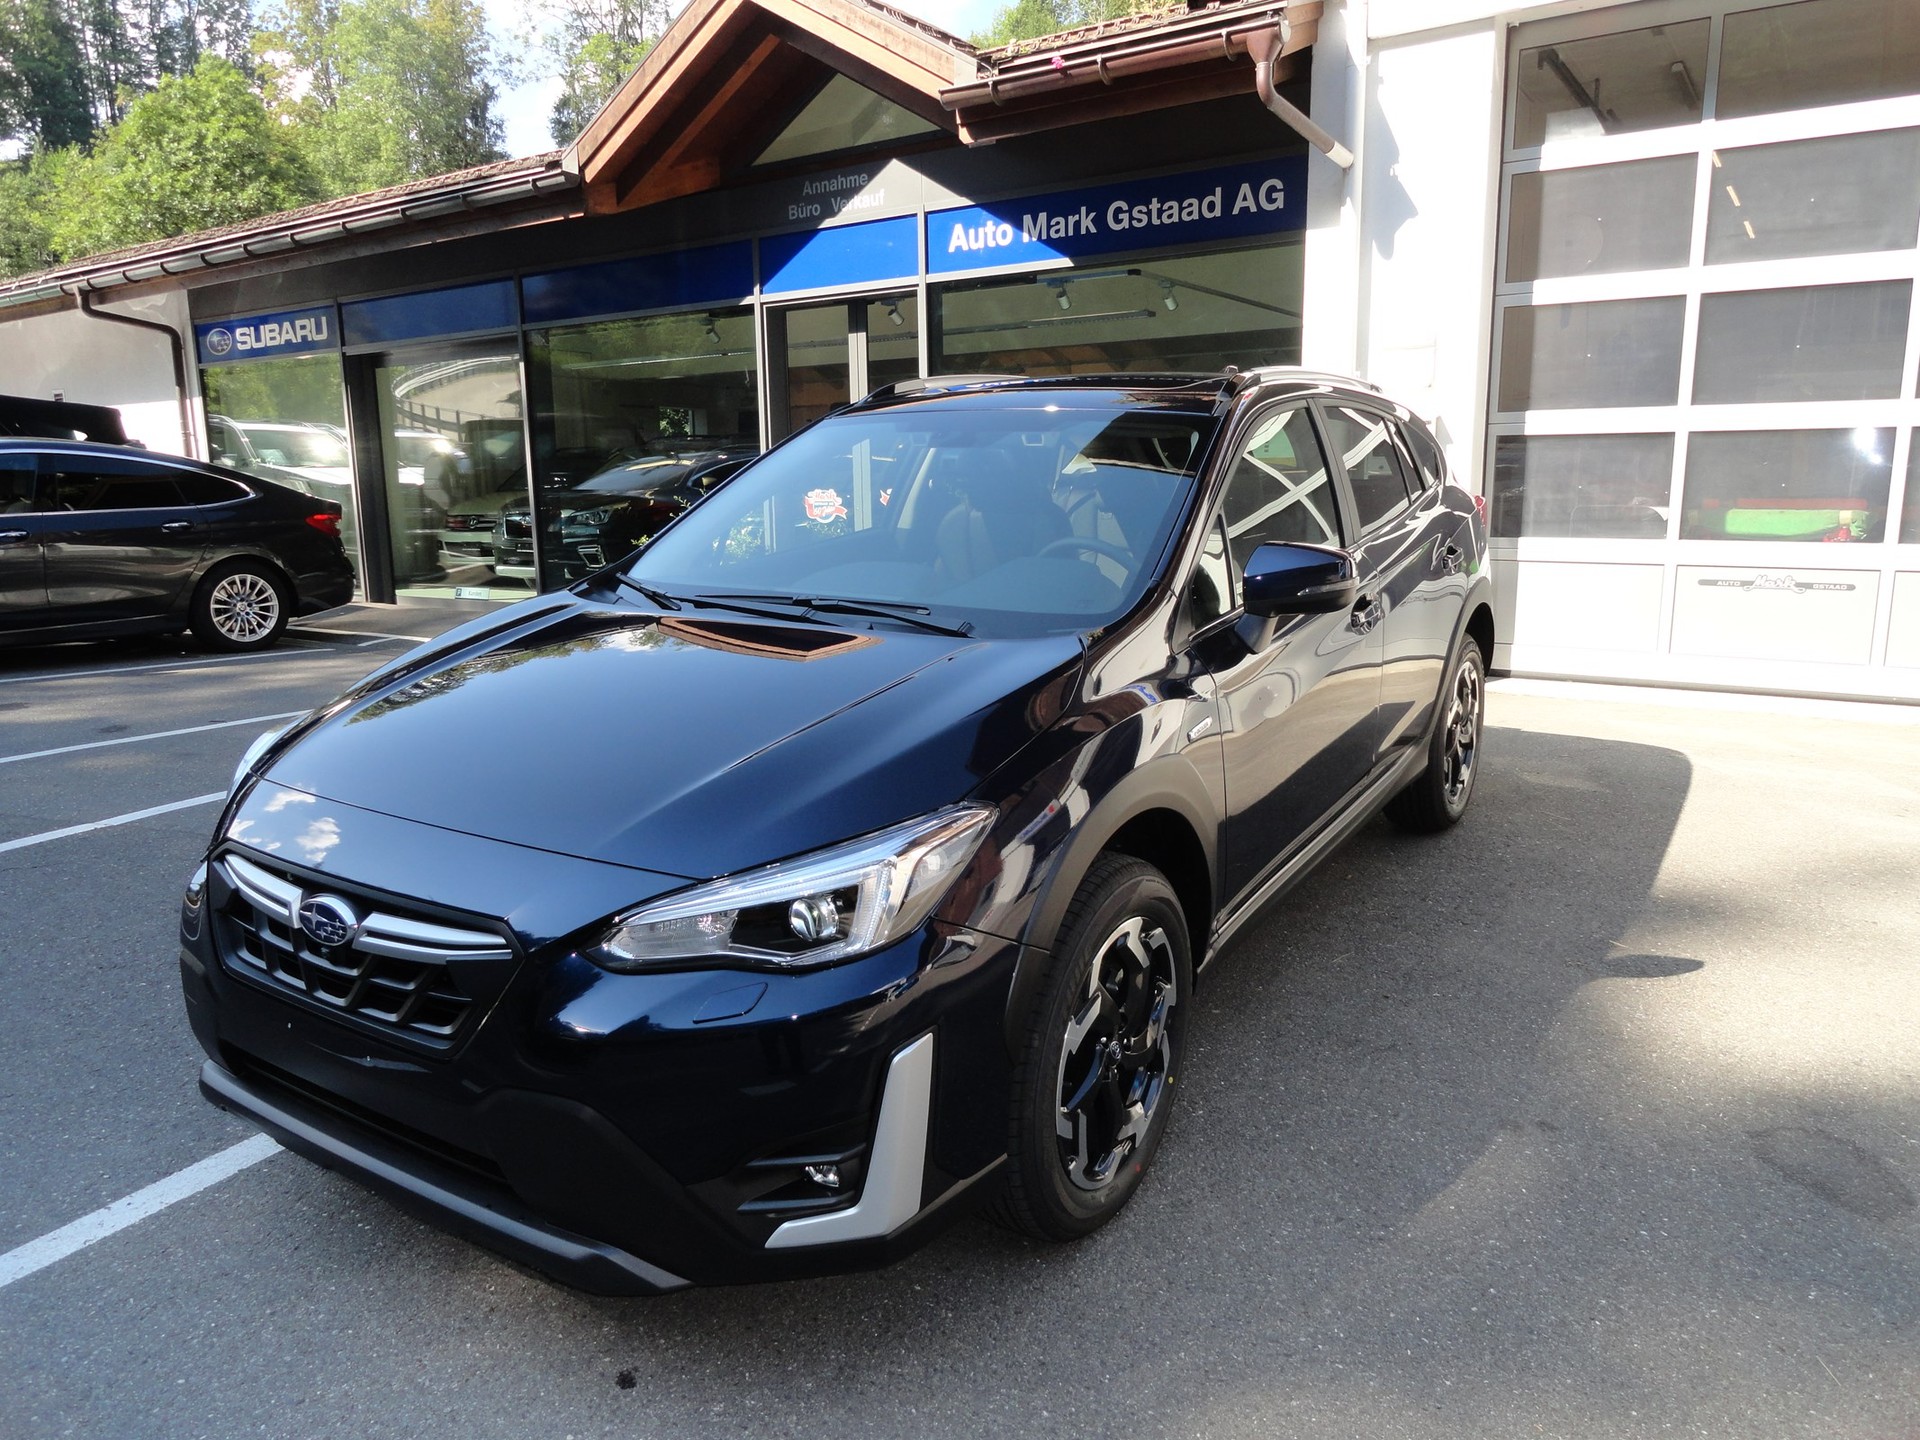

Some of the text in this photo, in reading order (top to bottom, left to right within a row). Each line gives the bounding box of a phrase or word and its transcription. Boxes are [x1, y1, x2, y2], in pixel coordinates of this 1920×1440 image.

[803, 173, 868, 196] Annahme
[788, 188, 885, 220] Büro Verkauf
[948, 178, 1285, 253] Auto Mark Gstaad AG
[235, 316, 328, 350] SUBARU
[1744, 575, 1807, 594] Mark
[1812, 583, 1848, 591] GSTAAD
